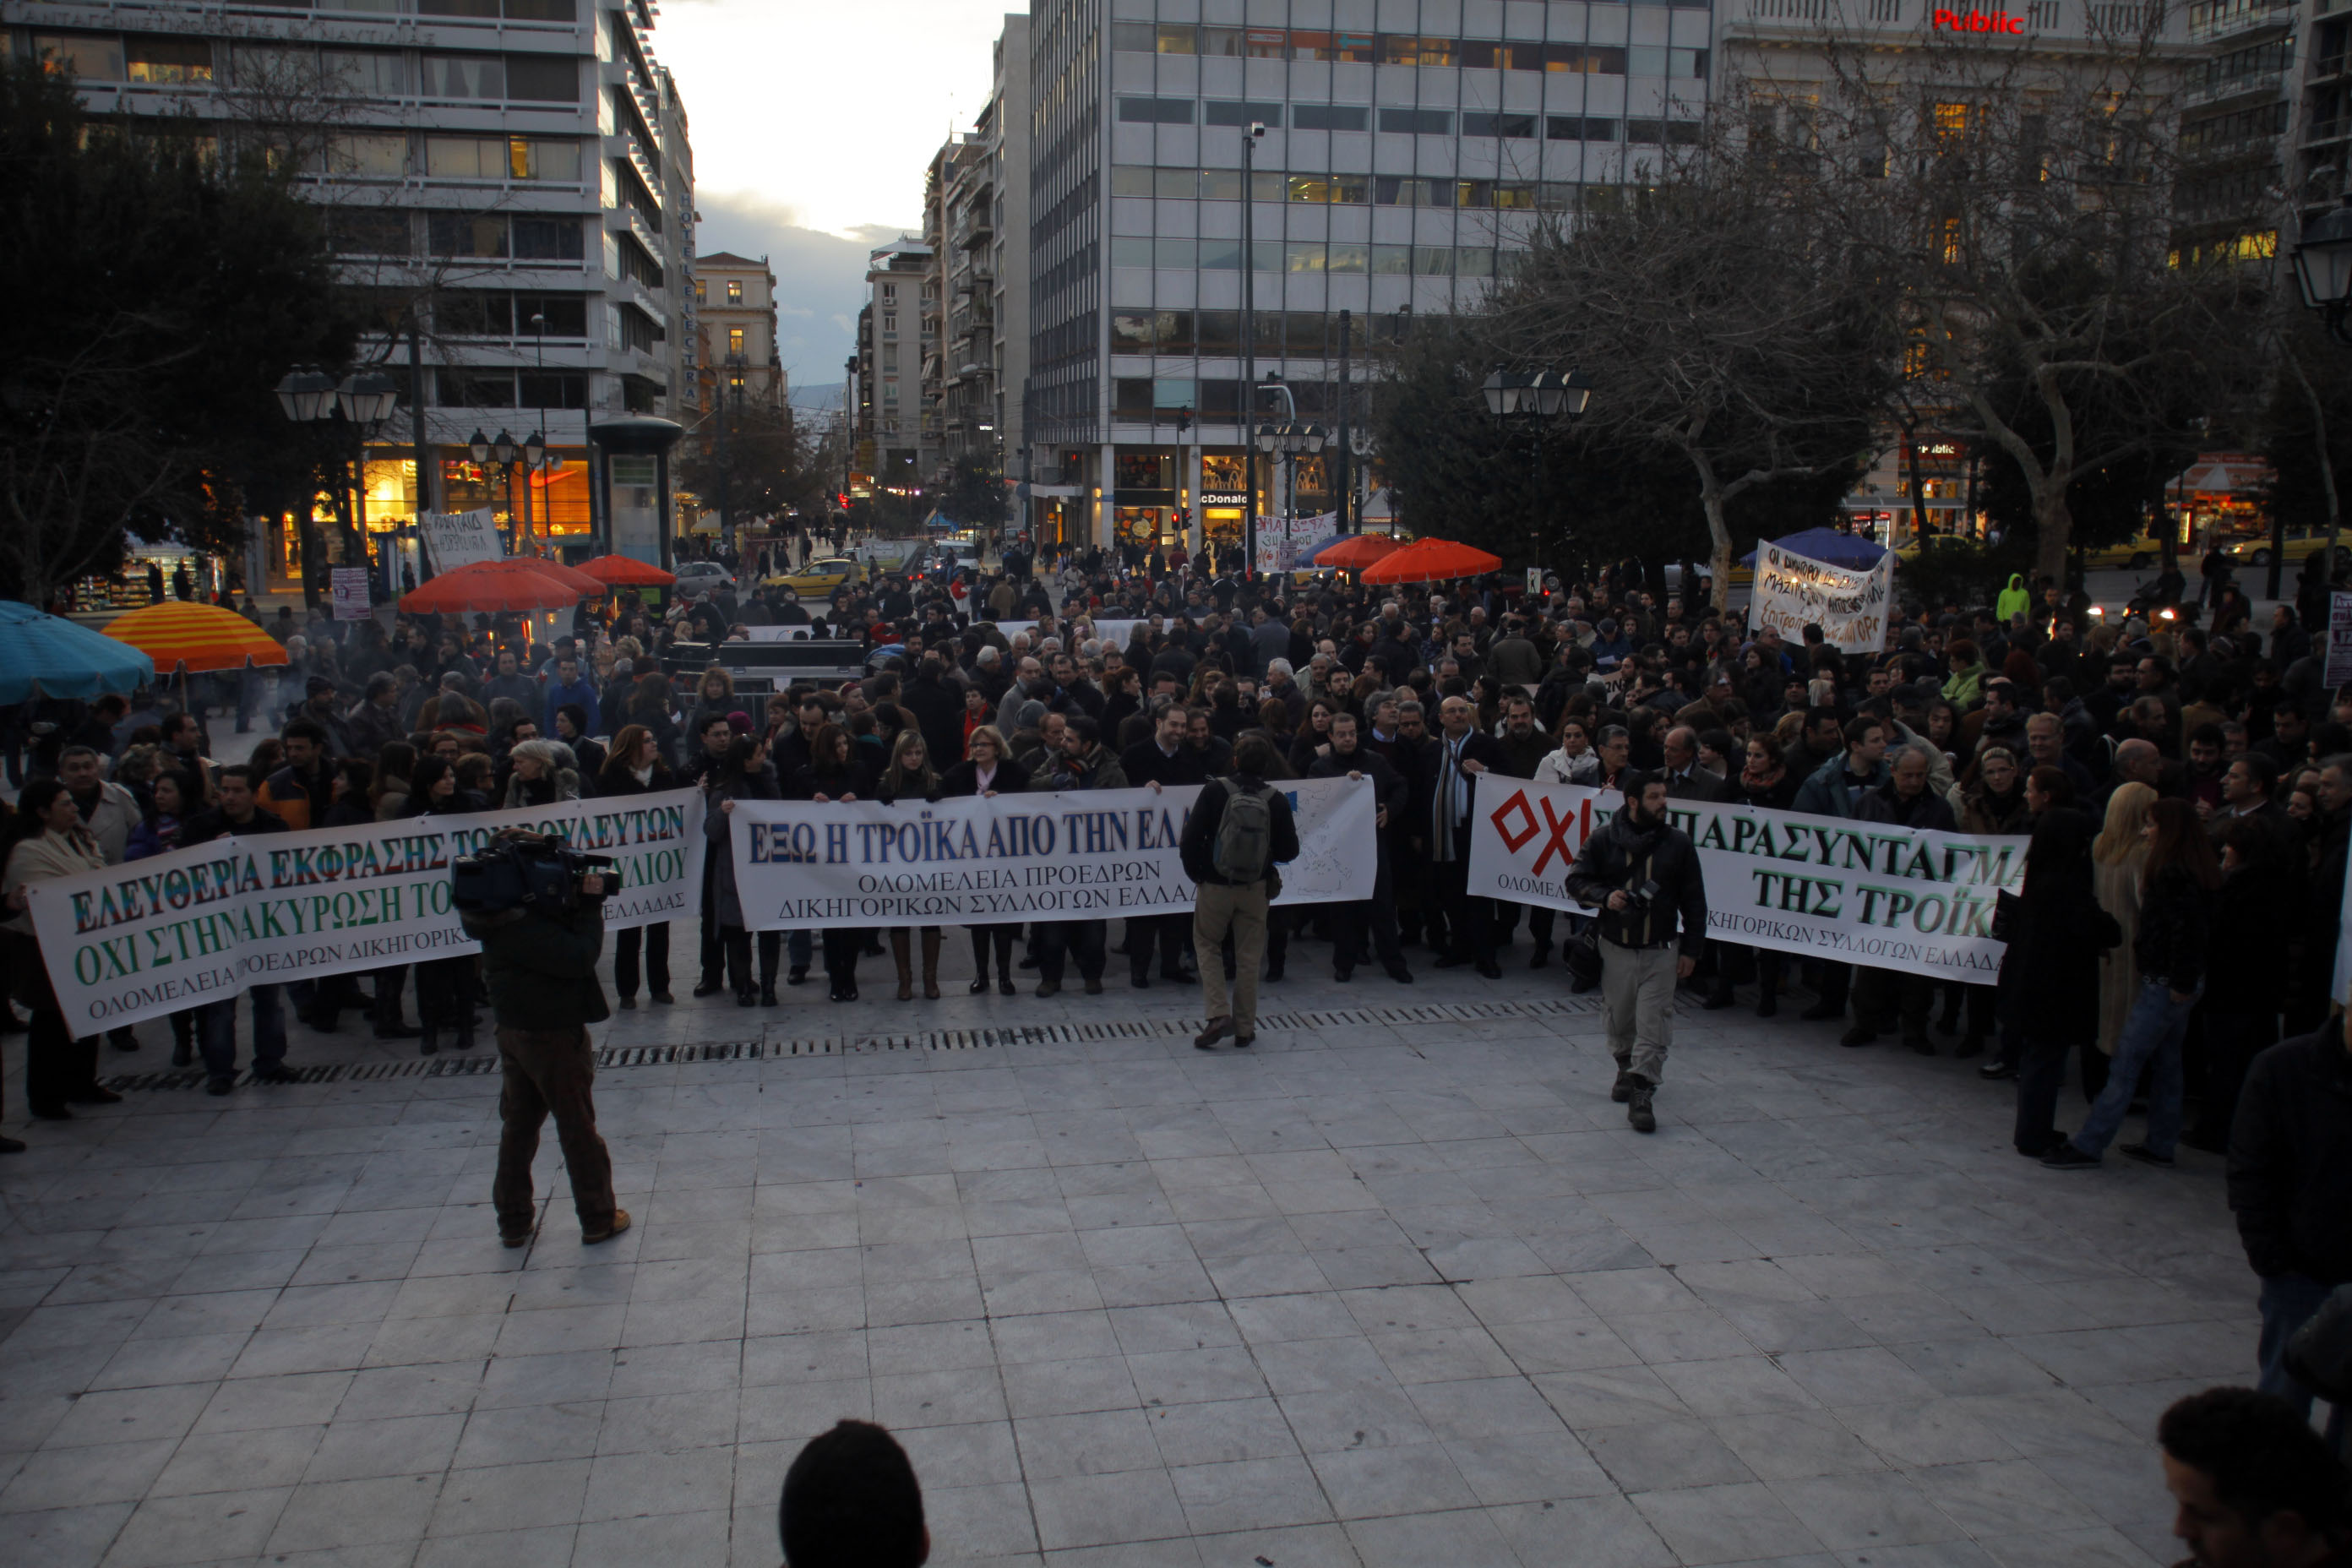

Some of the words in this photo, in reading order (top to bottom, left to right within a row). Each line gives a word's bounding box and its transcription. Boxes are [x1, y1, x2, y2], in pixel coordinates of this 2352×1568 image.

[1934, 8, 2025, 34] Public
[681, 194, 691, 275] HOTEL
[683, 286, 694, 398] ELECTRA
[748, 822, 817, 864] ΕΞΩ
[825, 823, 850, 863] Η
[856, 810, 982, 863] ΤΡΟΪΚΑ
[986, 814, 1056, 858] ΑΠΟ
[1062, 810, 1129, 855] ΤΗΝ
[1490, 788, 1591, 878] ΟΧΙ
[70, 852, 264, 935] ΕΛΕΥΘΕΡΙΑ
[269, 832, 448, 889] ΕΚΦΡΑΣΗΣ
[778, 896, 962, 919] ΔΙΚΗΓΟΡΙΚΩΝ
[970, 888, 1110, 914] ΣΥΛΛΟΓΩΝ
[858, 868, 1019, 894] ΟΛΟΜΕΛΕΙΑ
[1025, 860, 1161, 887] ΠΡΟΕΔΡΩΝ
[1752, 868, 1844, 919] ΤΗΣ
[1856, 882, 1997, 939] ΤΡΟΪΚ
[1498, 874, 1572, 901] ΟΛΟΜΕΛ
[1707, 910, 1815, 944] ΚΗΓΟΡΙΚΩΝ
[1817, 929, 1922, 961] ΣΥΛΛΟΓΩΝ
[75, 934, 143, 986] ΟΧΙ
[89, 966, 236, 1020] ΟΛΟΜΕΛΕΙΑ
[349, 926, 474, 960] ΔΙΚΗΓΟΡΙΚ
[603, 892, 685, 921] ΕΛΛΑΔΑΣ
